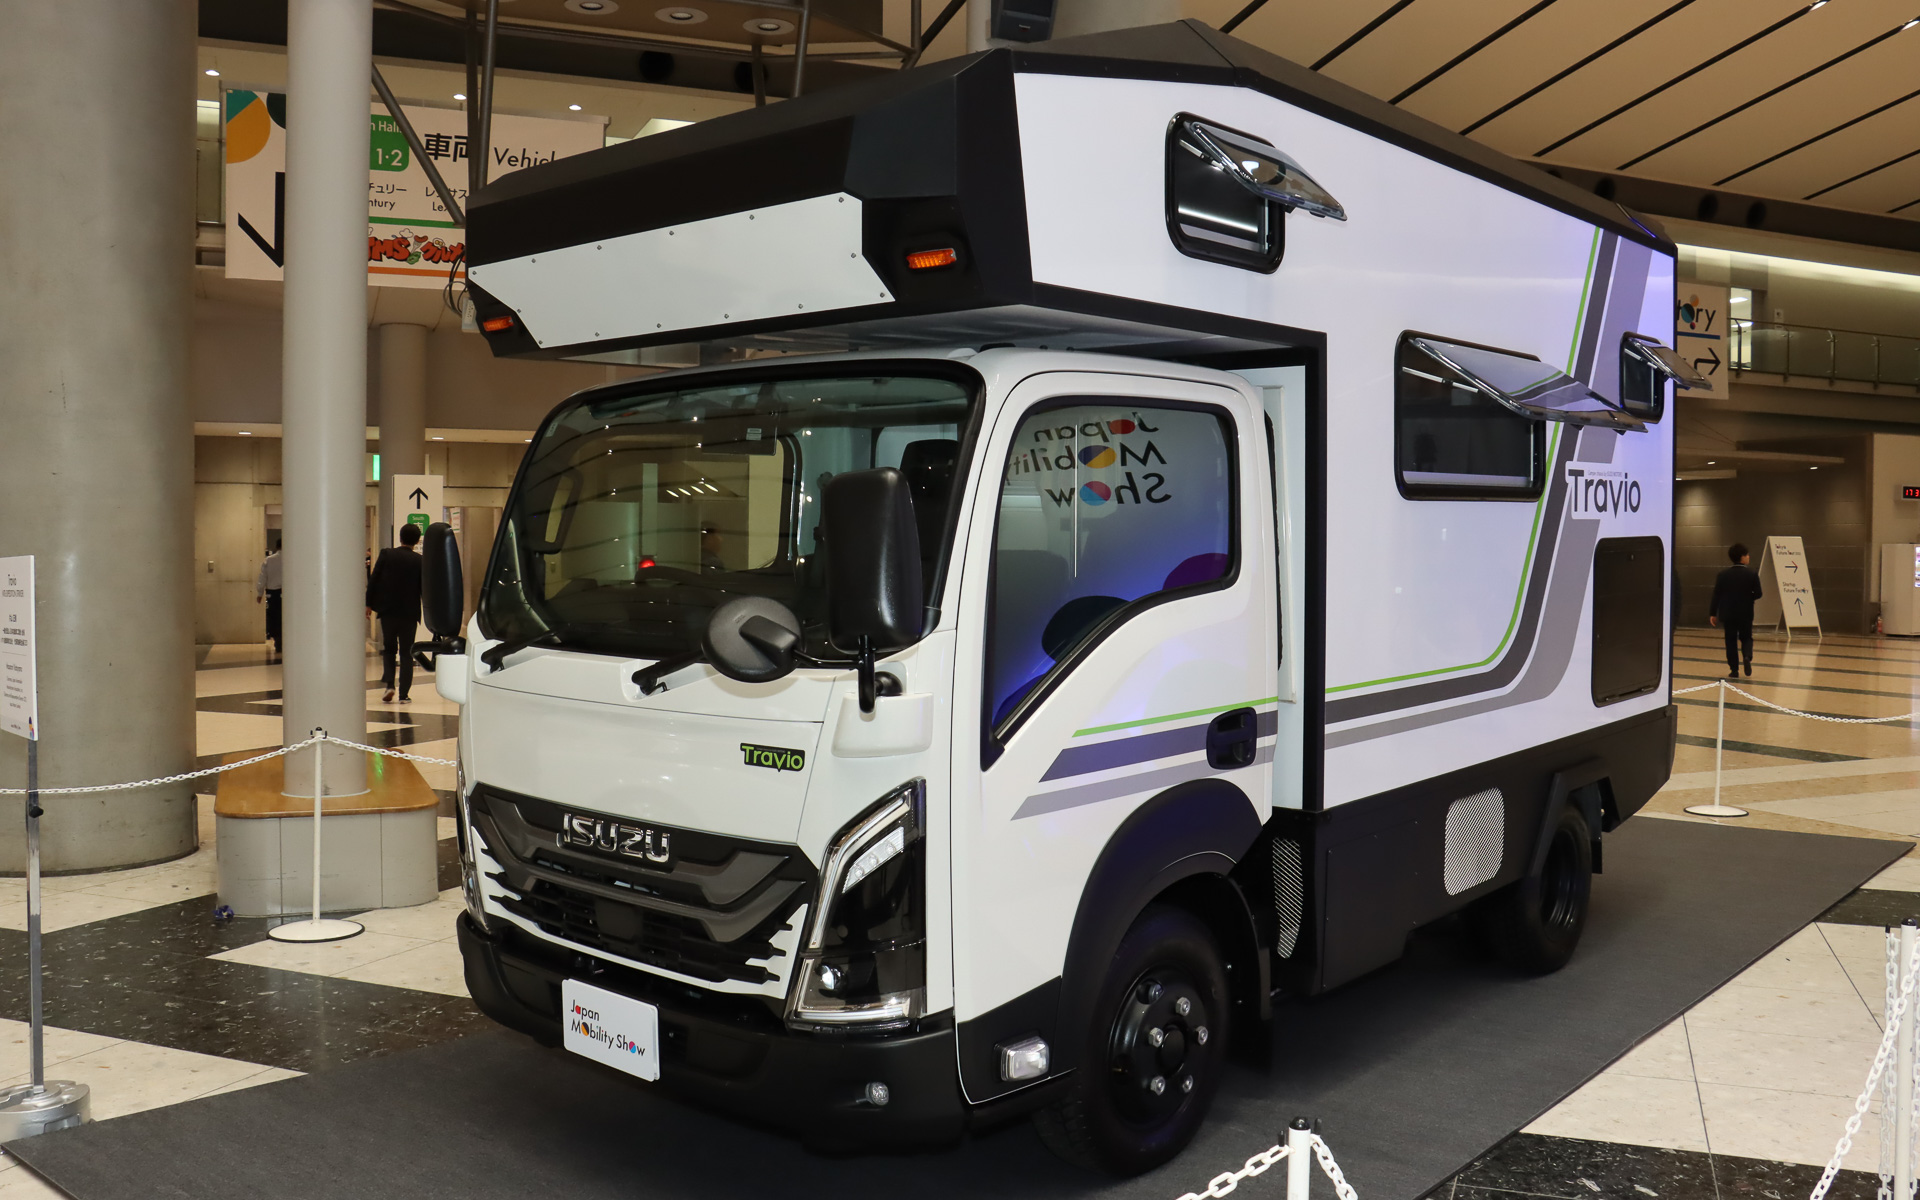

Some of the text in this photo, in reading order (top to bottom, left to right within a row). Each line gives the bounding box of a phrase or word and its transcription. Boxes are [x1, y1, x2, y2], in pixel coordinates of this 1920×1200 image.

[379, 120, 402, 133] Hall
[369, 182, 407, 194] チュリー
[369, 199, 396, 211] ntury
[1677, 299, 1716, 332] tory
[1568, 469, 1641, 519] Travio
[741, 745, 803, 771] Travio
[562, 812, 671, 863] ISUZU
[570, 999, 600, 1021] Japan
[571, 1018, 646, 1056] Mobility Show
